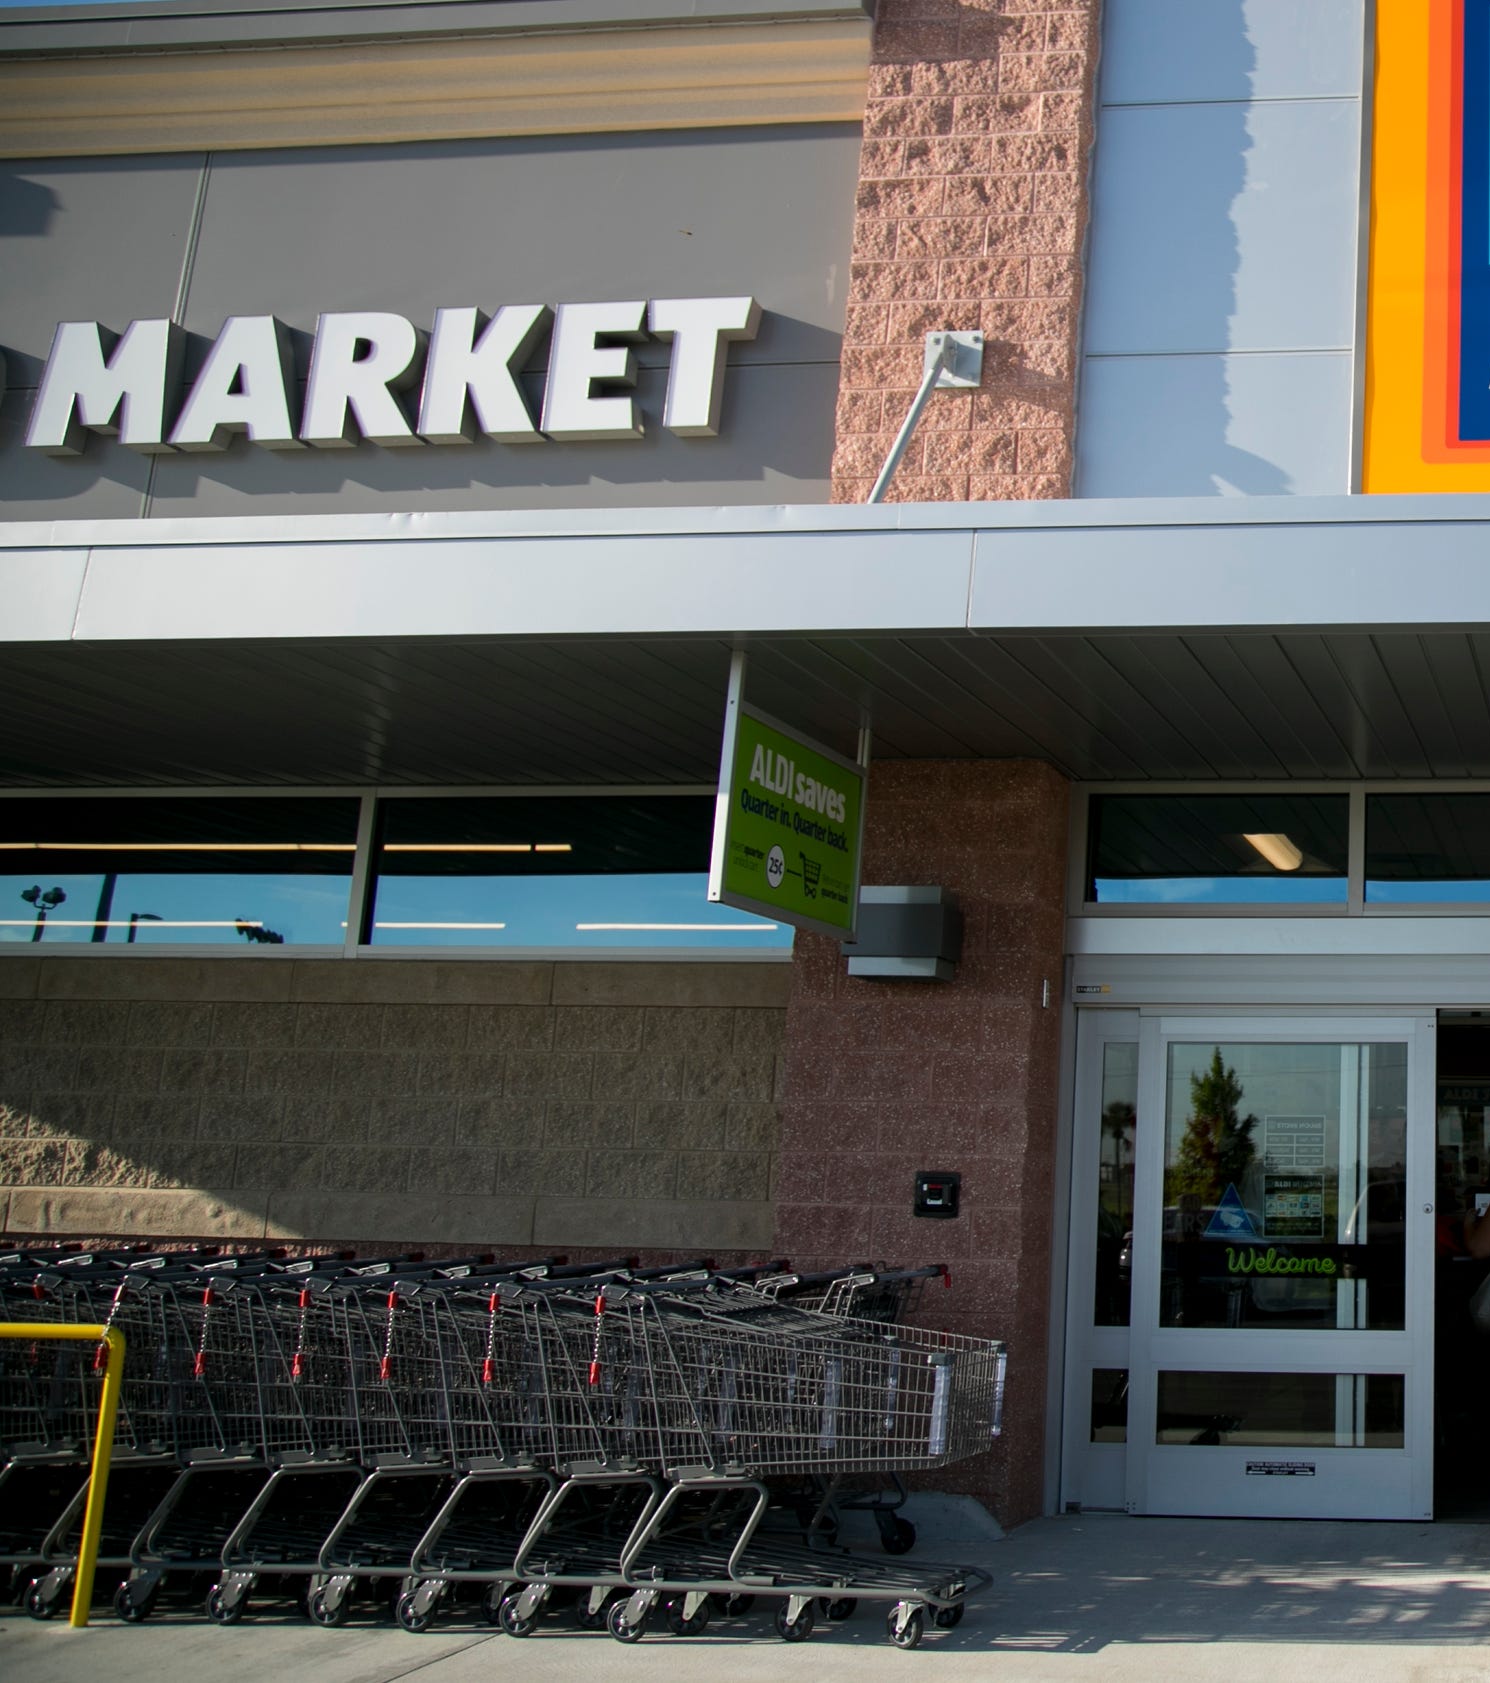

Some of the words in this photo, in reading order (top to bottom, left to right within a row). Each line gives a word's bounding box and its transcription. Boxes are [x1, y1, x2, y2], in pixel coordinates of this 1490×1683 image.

[25, 296, 762, 454] MARKET
[749, 743, 795, 800] ALDI
[794, 772, 846, 824] saves
[741, 788, 779, 823] Quarter
[780, 802, 792, 828] in.
[793, 811, 828, 842] Quarter
[827, 825, 849, 853] back.
[768, 856, 783, 875] 25¢
[1225, 1247, 1336, 1275] Welcome
